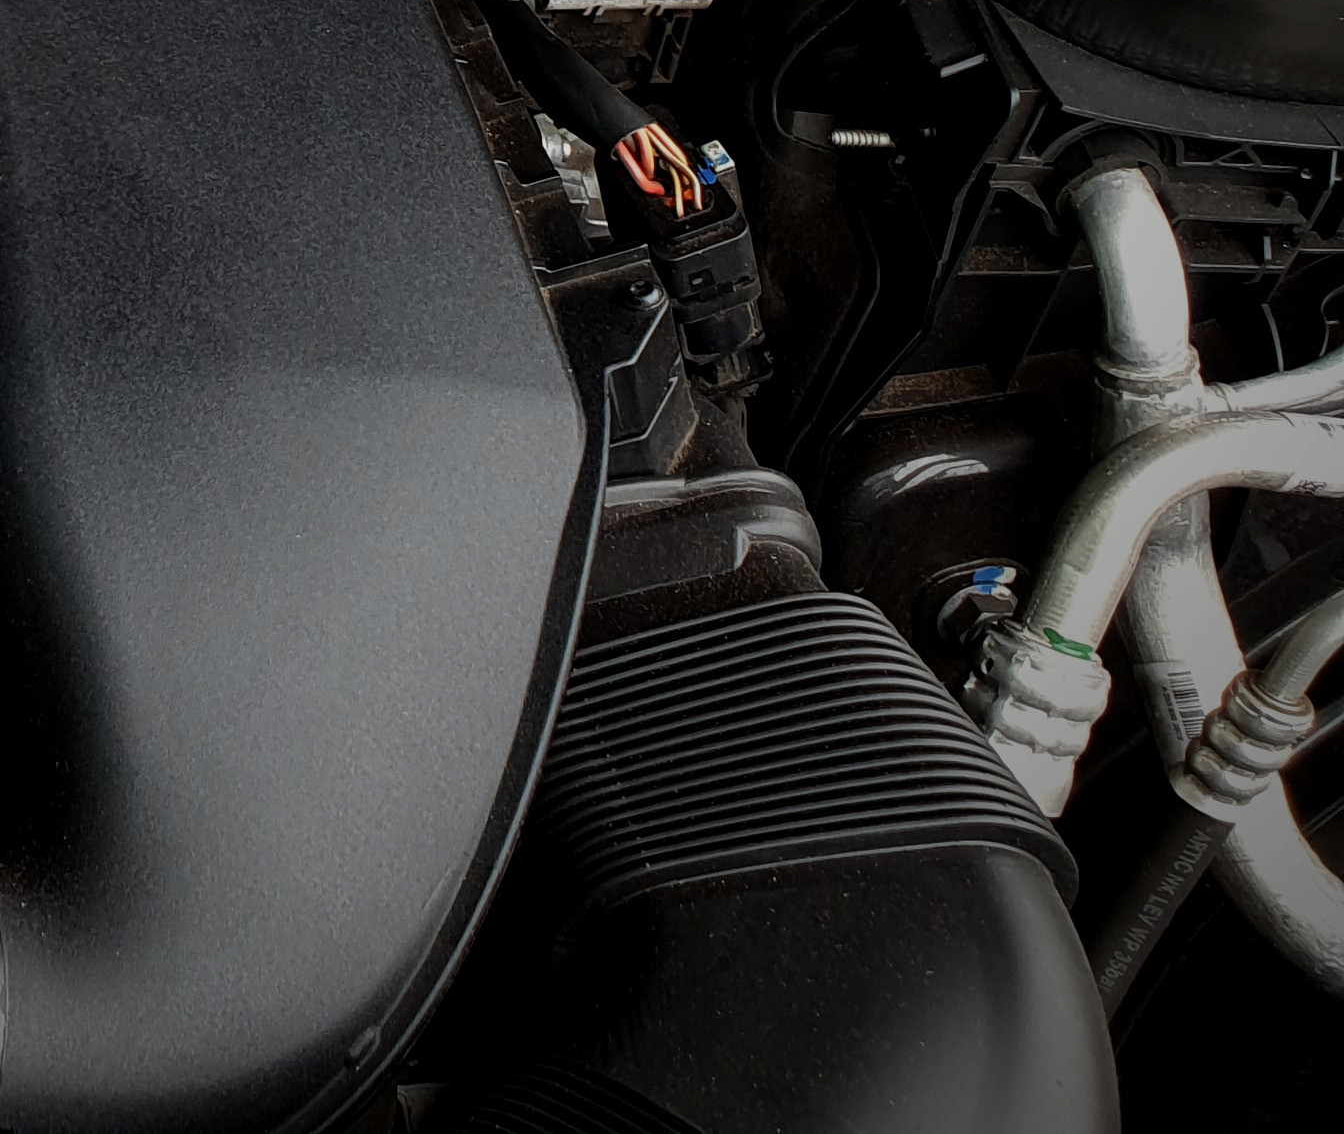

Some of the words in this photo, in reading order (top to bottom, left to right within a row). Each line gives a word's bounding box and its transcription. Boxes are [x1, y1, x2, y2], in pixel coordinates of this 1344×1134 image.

[1173, 828, 1212, 874] ARTIC
[1137, 893, 1170, 928] LEV
[1123, 926, 1150, 953] WP
